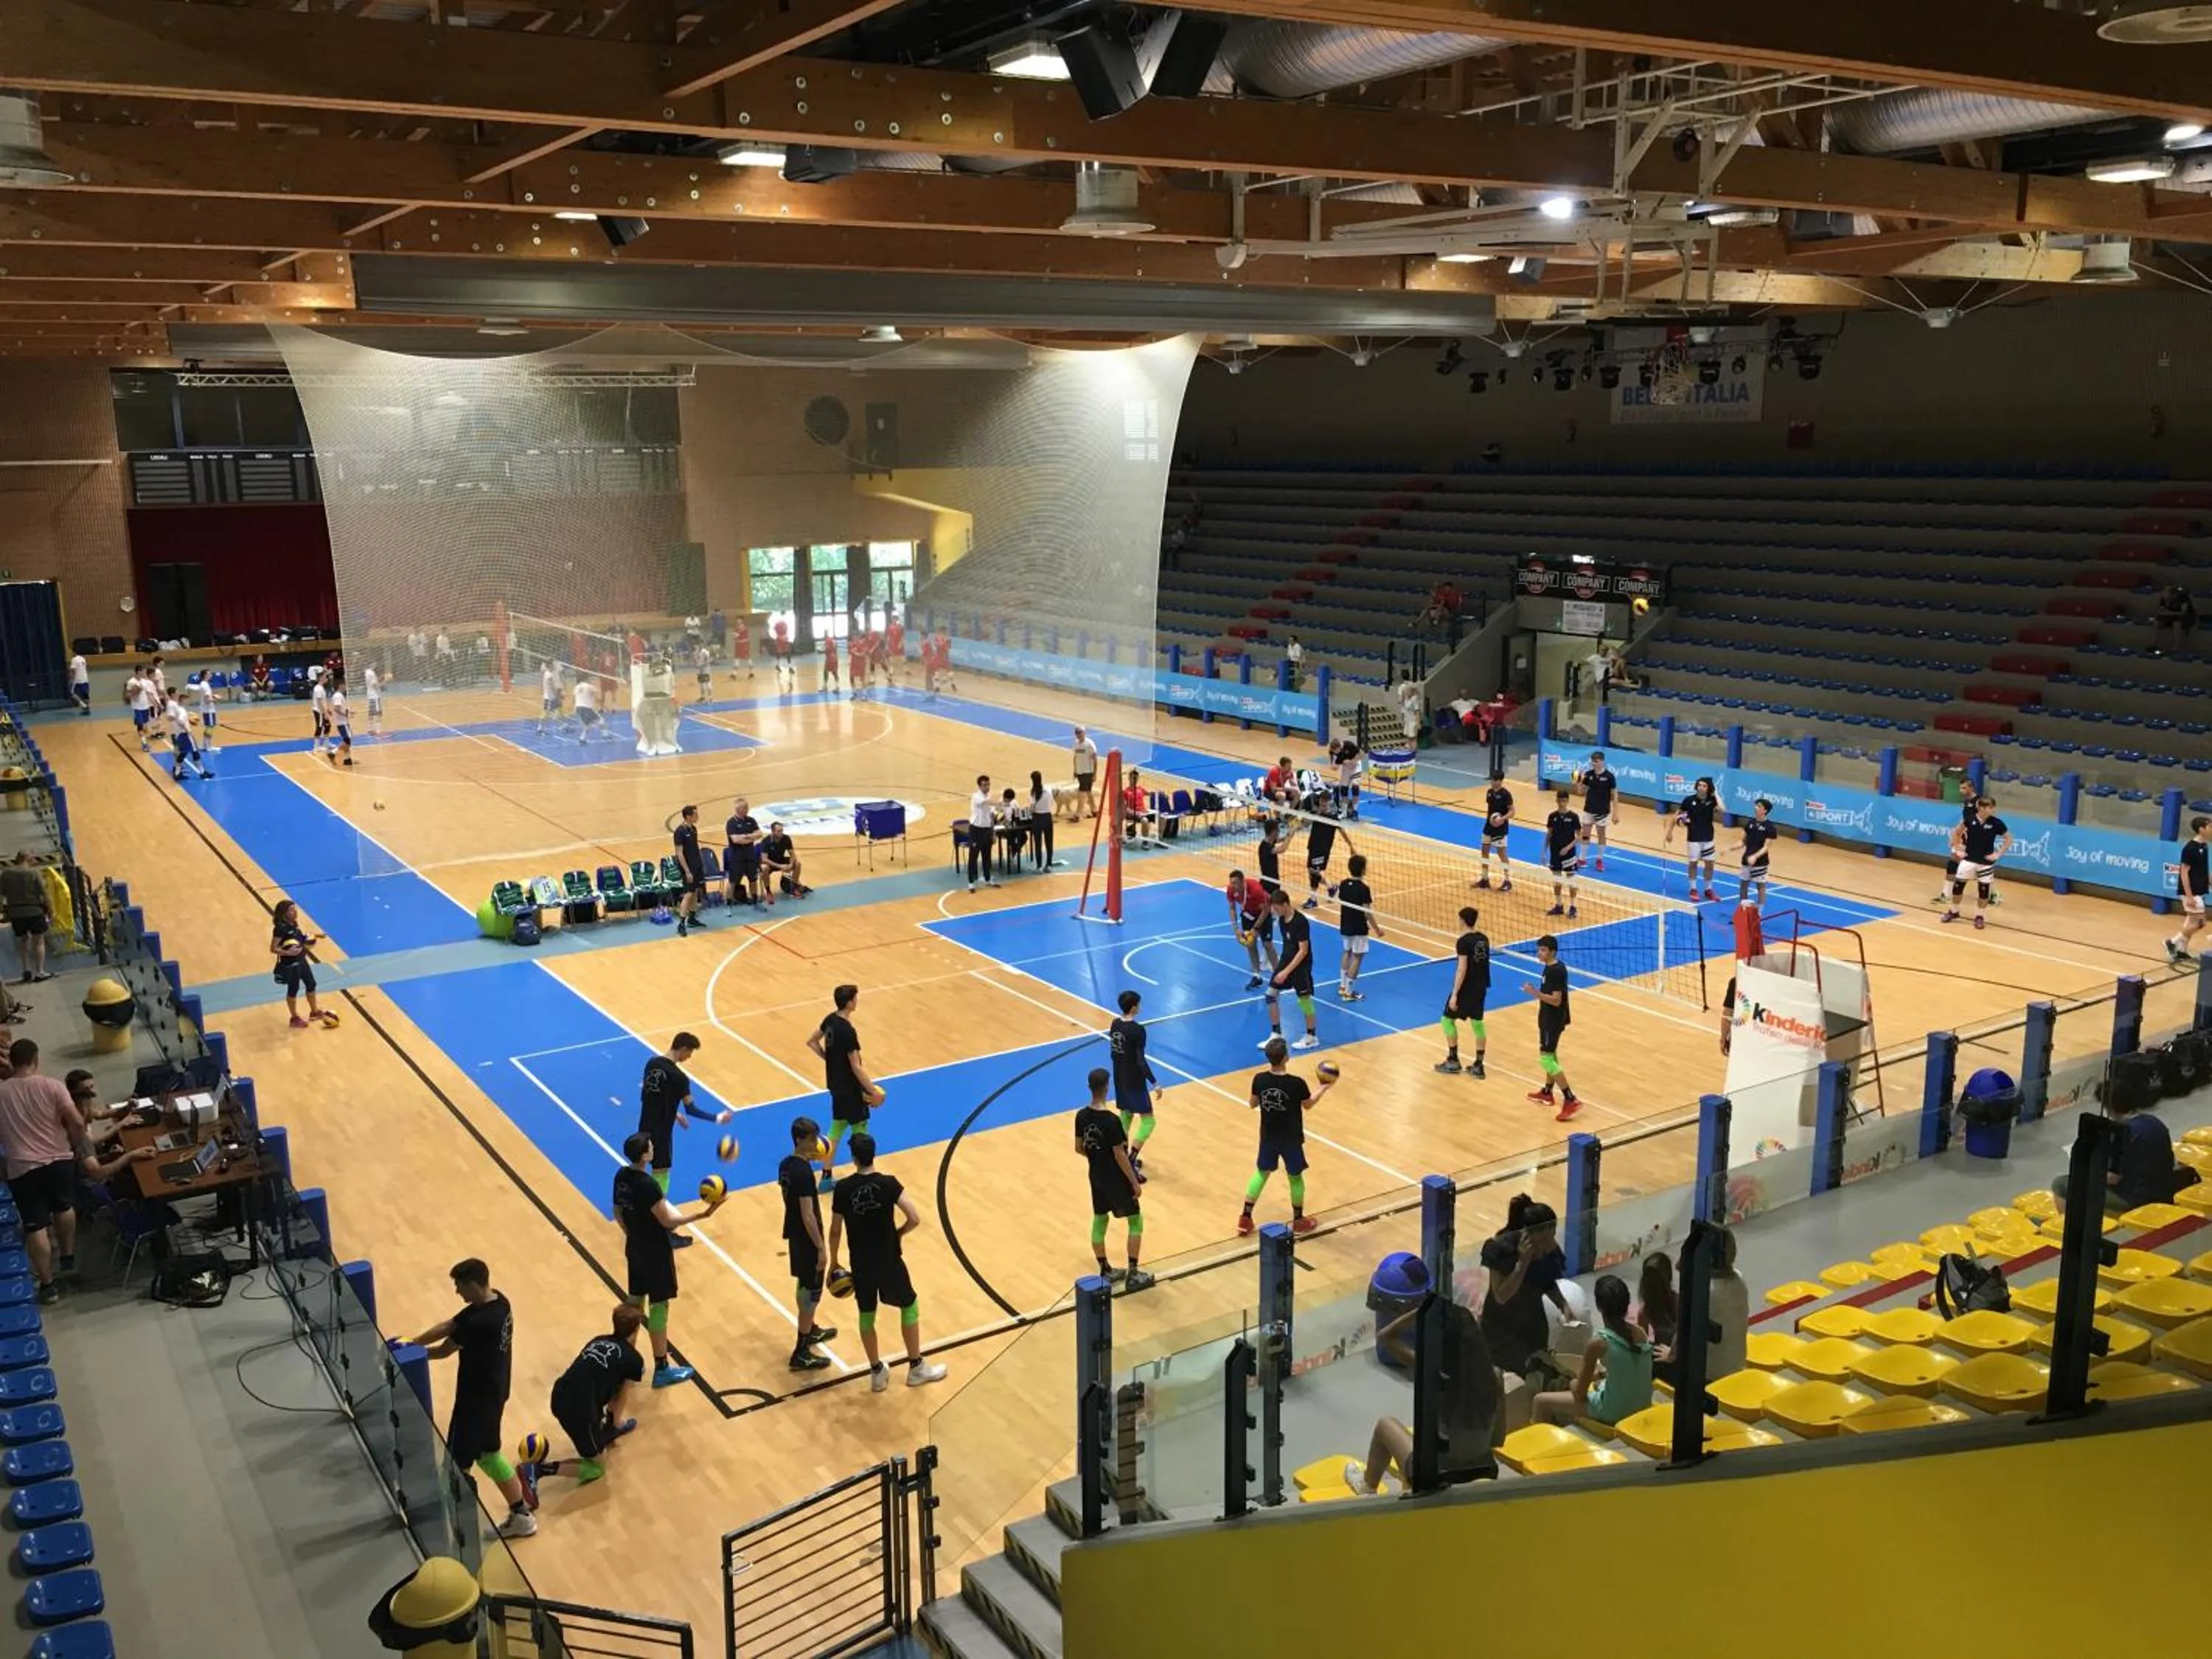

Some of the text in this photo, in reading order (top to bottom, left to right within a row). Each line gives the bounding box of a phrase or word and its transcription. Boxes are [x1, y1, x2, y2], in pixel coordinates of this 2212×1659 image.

[1518, 571, 1555, 585] COMPANY
[1567, 575, 1605, 588] COMPANY
[1618, 580, 1660, 594] COMPANY
[1735, 786, 1752, 801] Joy
[1762, 793, 1794, 809] moving
[1885, 815, 1952, 835] Joy of movin
[2066, 846, 2088, 863] Joy
[2090, 850, 2103, 863] of
[2105, 853, 2150, 873] moving
